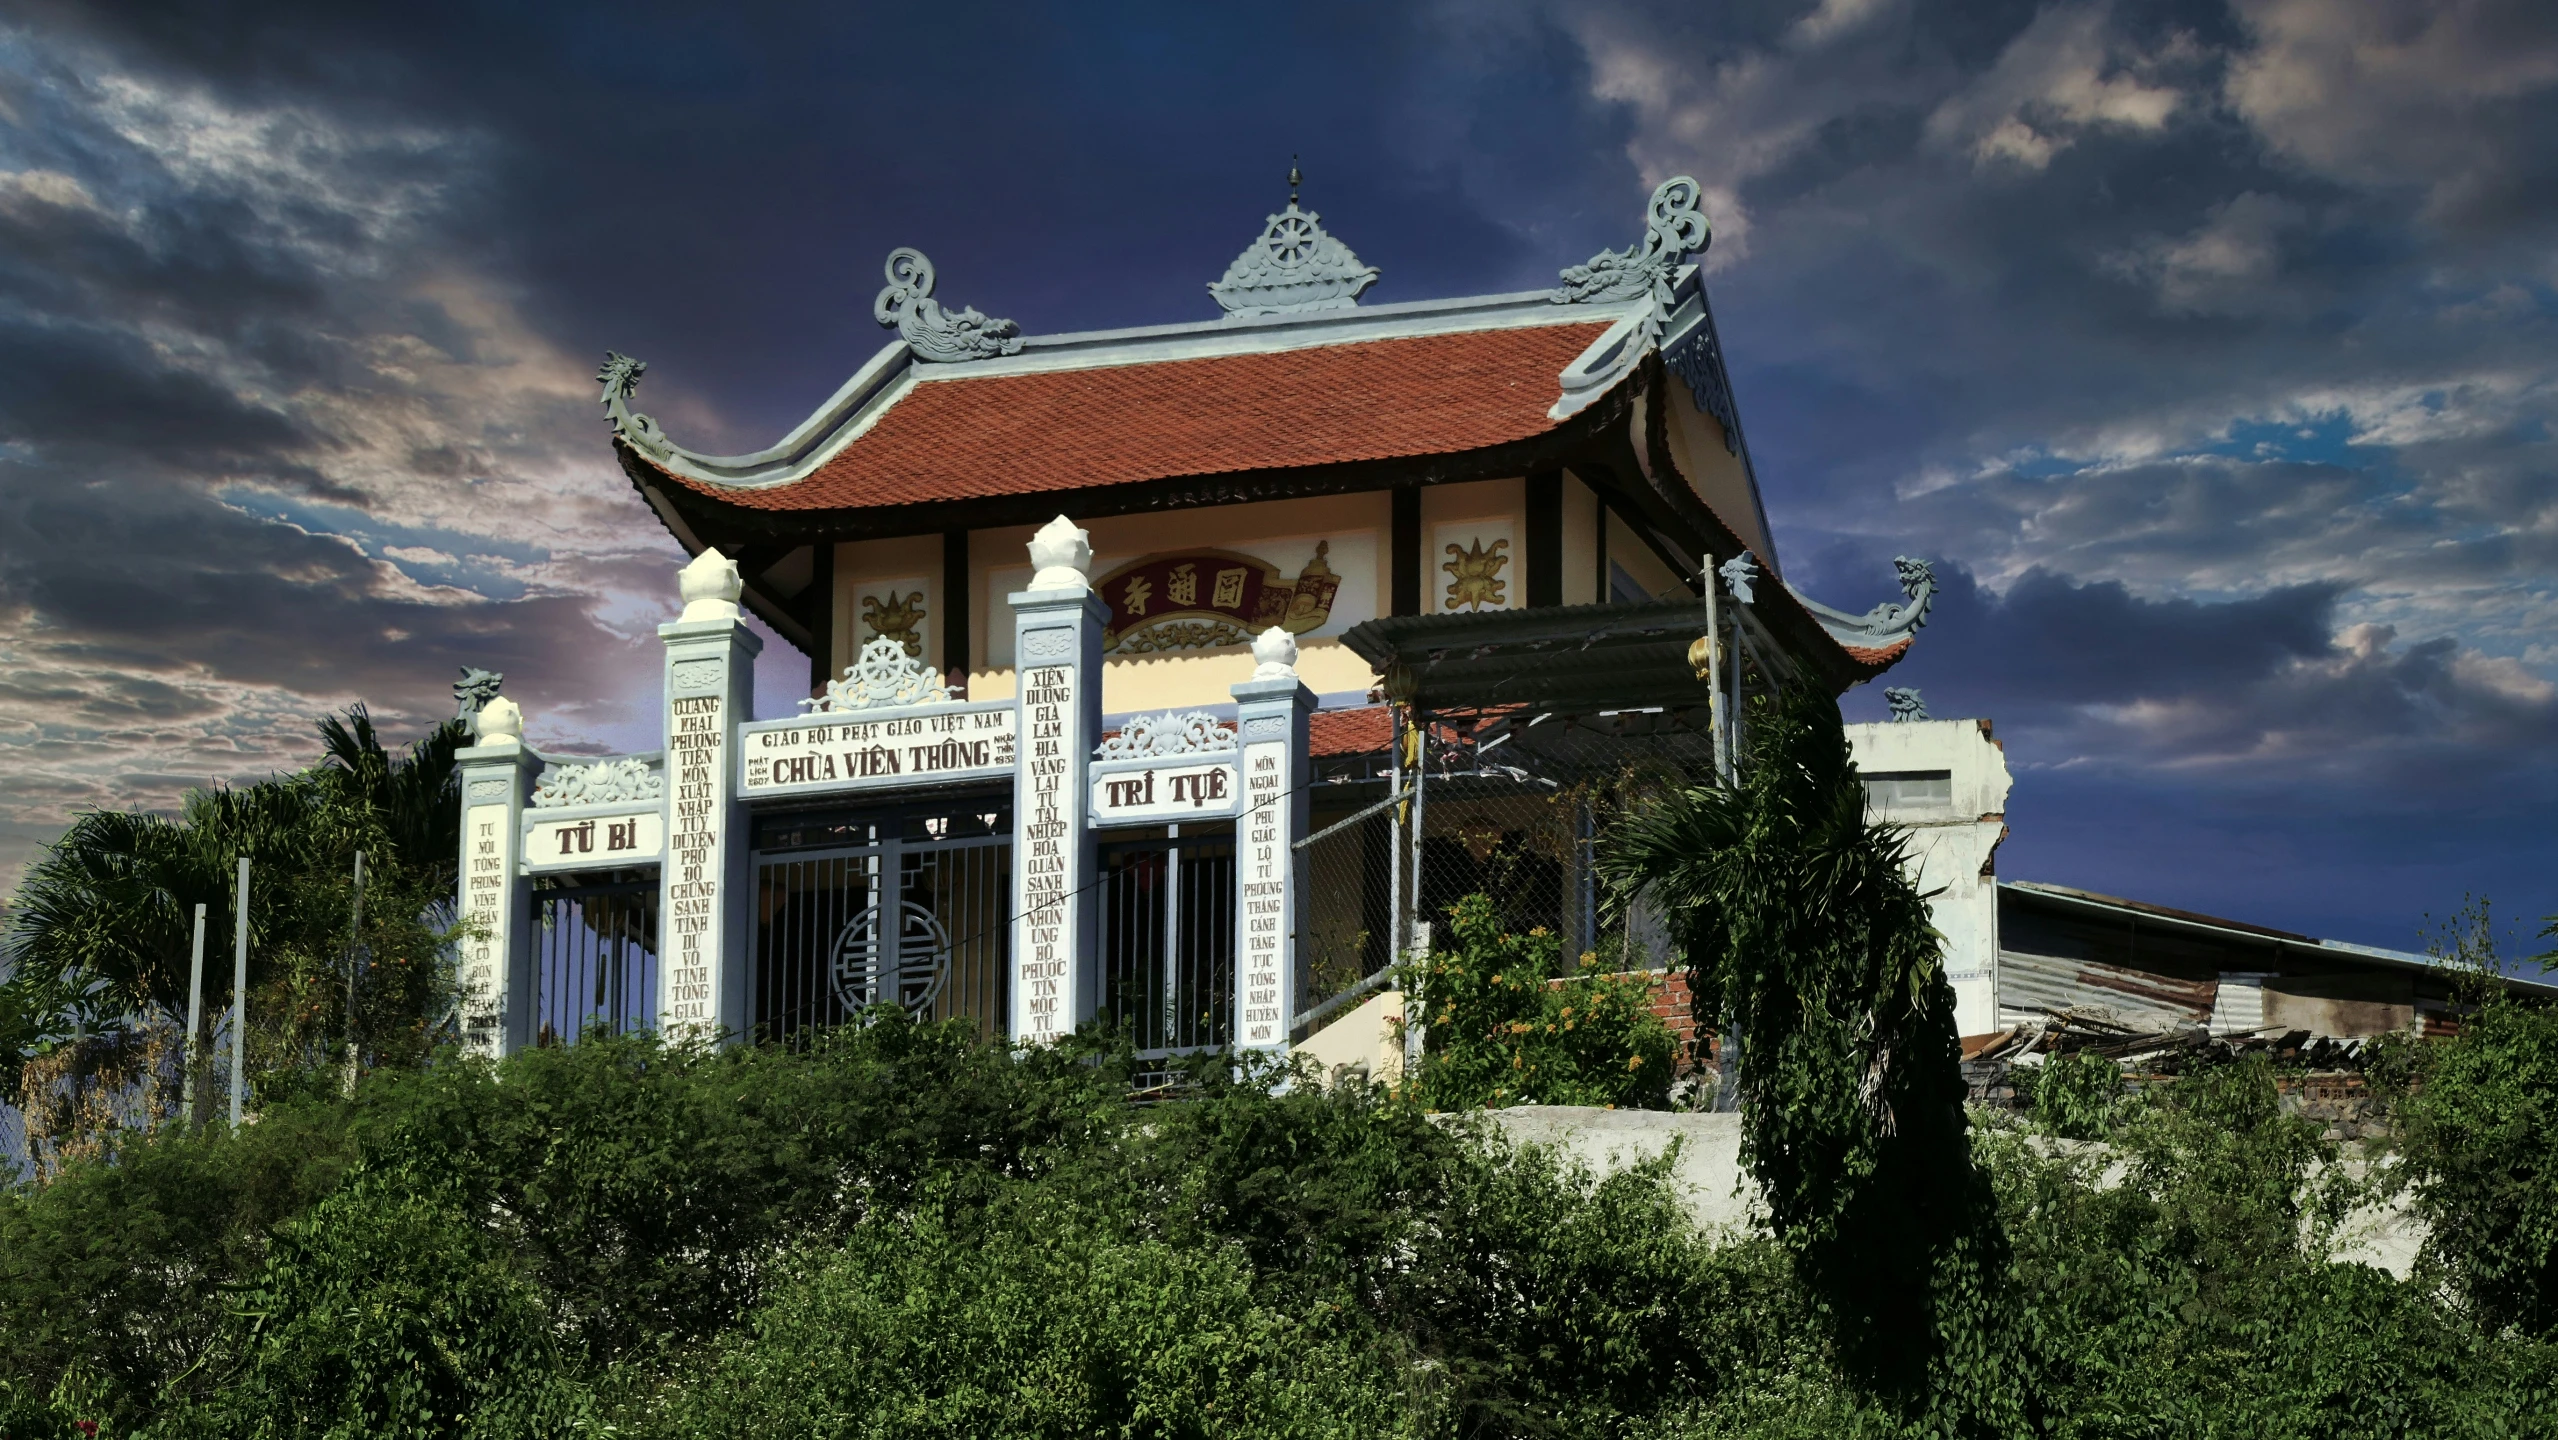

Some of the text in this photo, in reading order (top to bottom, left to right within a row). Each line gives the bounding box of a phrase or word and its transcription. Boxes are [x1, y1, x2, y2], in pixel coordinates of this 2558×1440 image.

[674, 697, 719, 715] QUANG
[1036, 703, 1060, 722] GIÀ
[680, 715, 713, 732] KHAI
[762, 712, 1003, 748] GIÁO HỘI PHẬT GIÁO VIỆT NAM
[1033, 722, 1062, 739] LAM
[1035, 740, 1059, 758] ĐỊA
[773, 737, 990, 785] CHÙA VIÊN THÔNG
[1255, 755, 1275, 771] MÔN
[1035, 775, 1059, 793] LAI
[1106, 769, 1155, 807] TRÍ
[1249, 774, 1279, 791] NGOẠI
[1253, 792, 1276, 807] KHAI
[1251, 825, 1276, 843] GIÁC
[470, 875, 501, 890] PHONG
[1027, 874, 1063, 892] SANH
[674, 898, 710, 916] SANH
[682, 948, 700, 966] VÔ
[674, 1002, 705, 1019] GIAI
